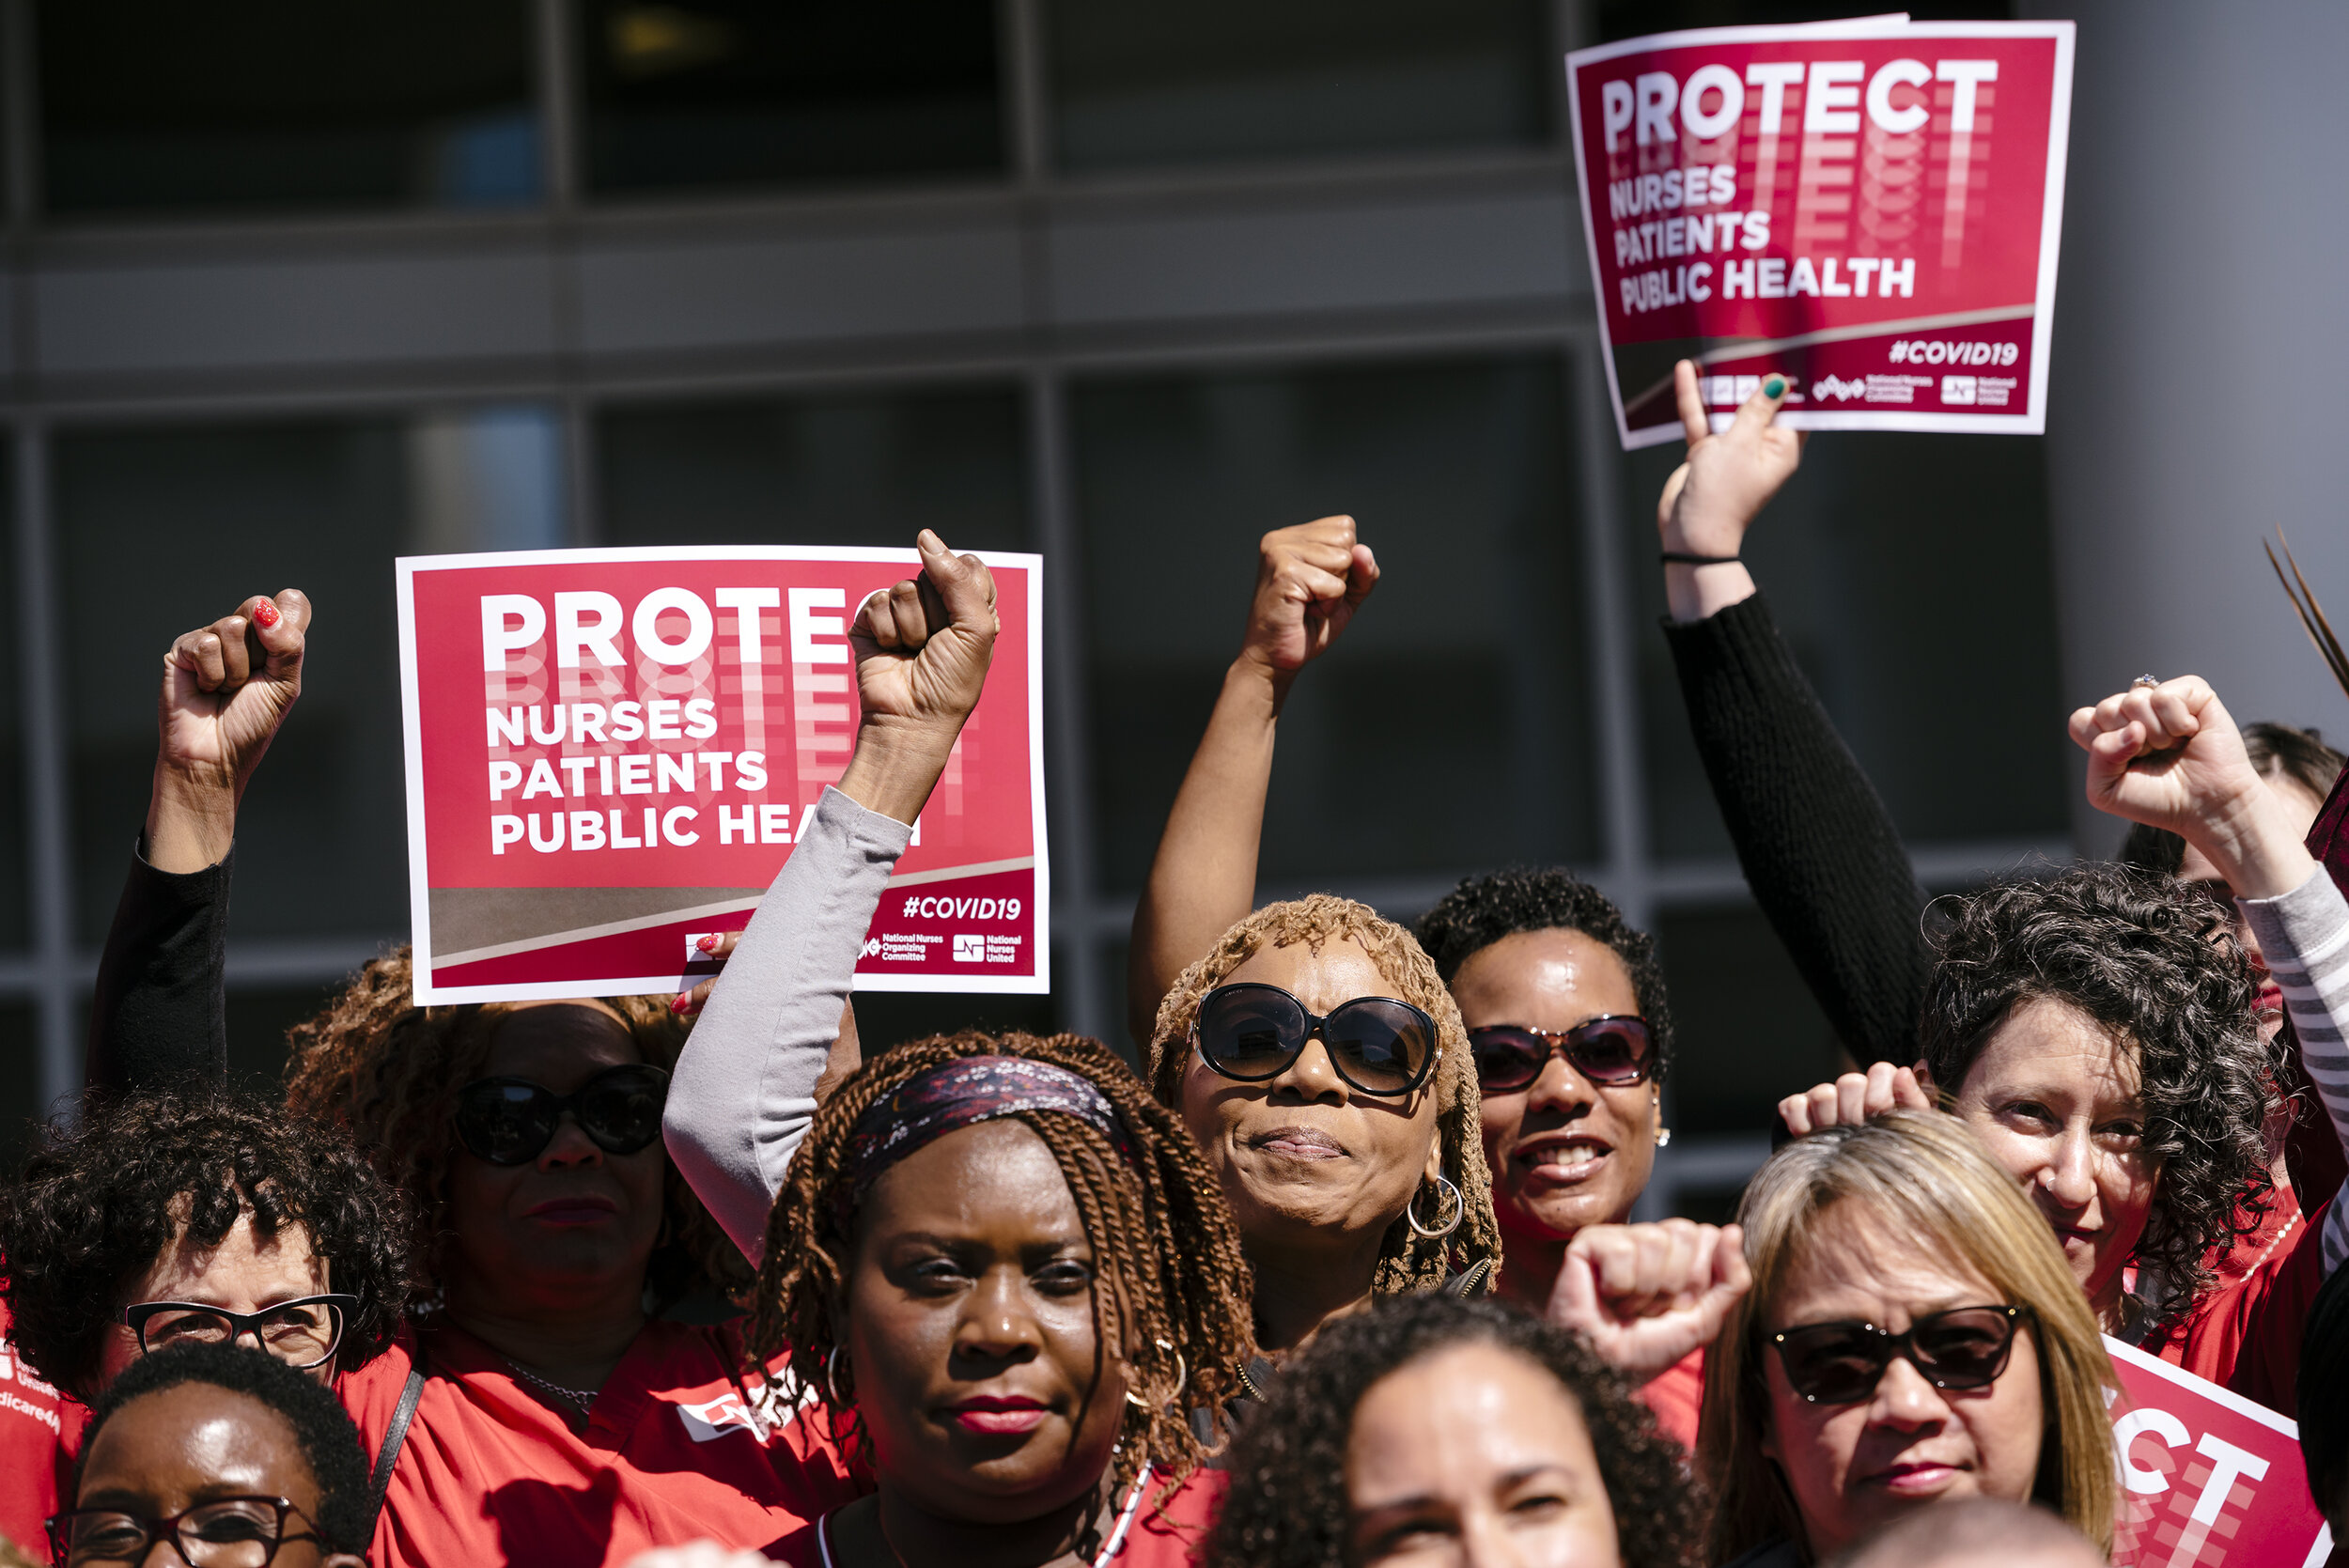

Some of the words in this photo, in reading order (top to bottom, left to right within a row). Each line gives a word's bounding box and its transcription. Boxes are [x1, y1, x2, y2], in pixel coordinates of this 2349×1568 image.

[1602, 58, 1999, 154] PROTECT
[1610, 164, 1736, 220] NURSES
[1615, 210, 1771, 267] PATIENTS
[1621, 262, 1712, 315] PUBLIC
[1722, 257, 1916, 299] HEALTH
[1888, 340, 2019, 366] #COVID19
[486, 698, 718, 747] NURSES
[489, 751, 768, 801] PATIENTS
[490, 805, 700, 855] PUBLIC
[903, 896, 1021, 921] #COVID19
[881, 942, 926, 953] Organizing
[882, 933, 915, 943] National
[916, 934, 944, 943] Nurses
[986, 935, 1022, 945] National
[986, 944, 1016, 954] Nurses
[881, 952, 926, 962] Committee
[986, 953, 1015, 963] United
